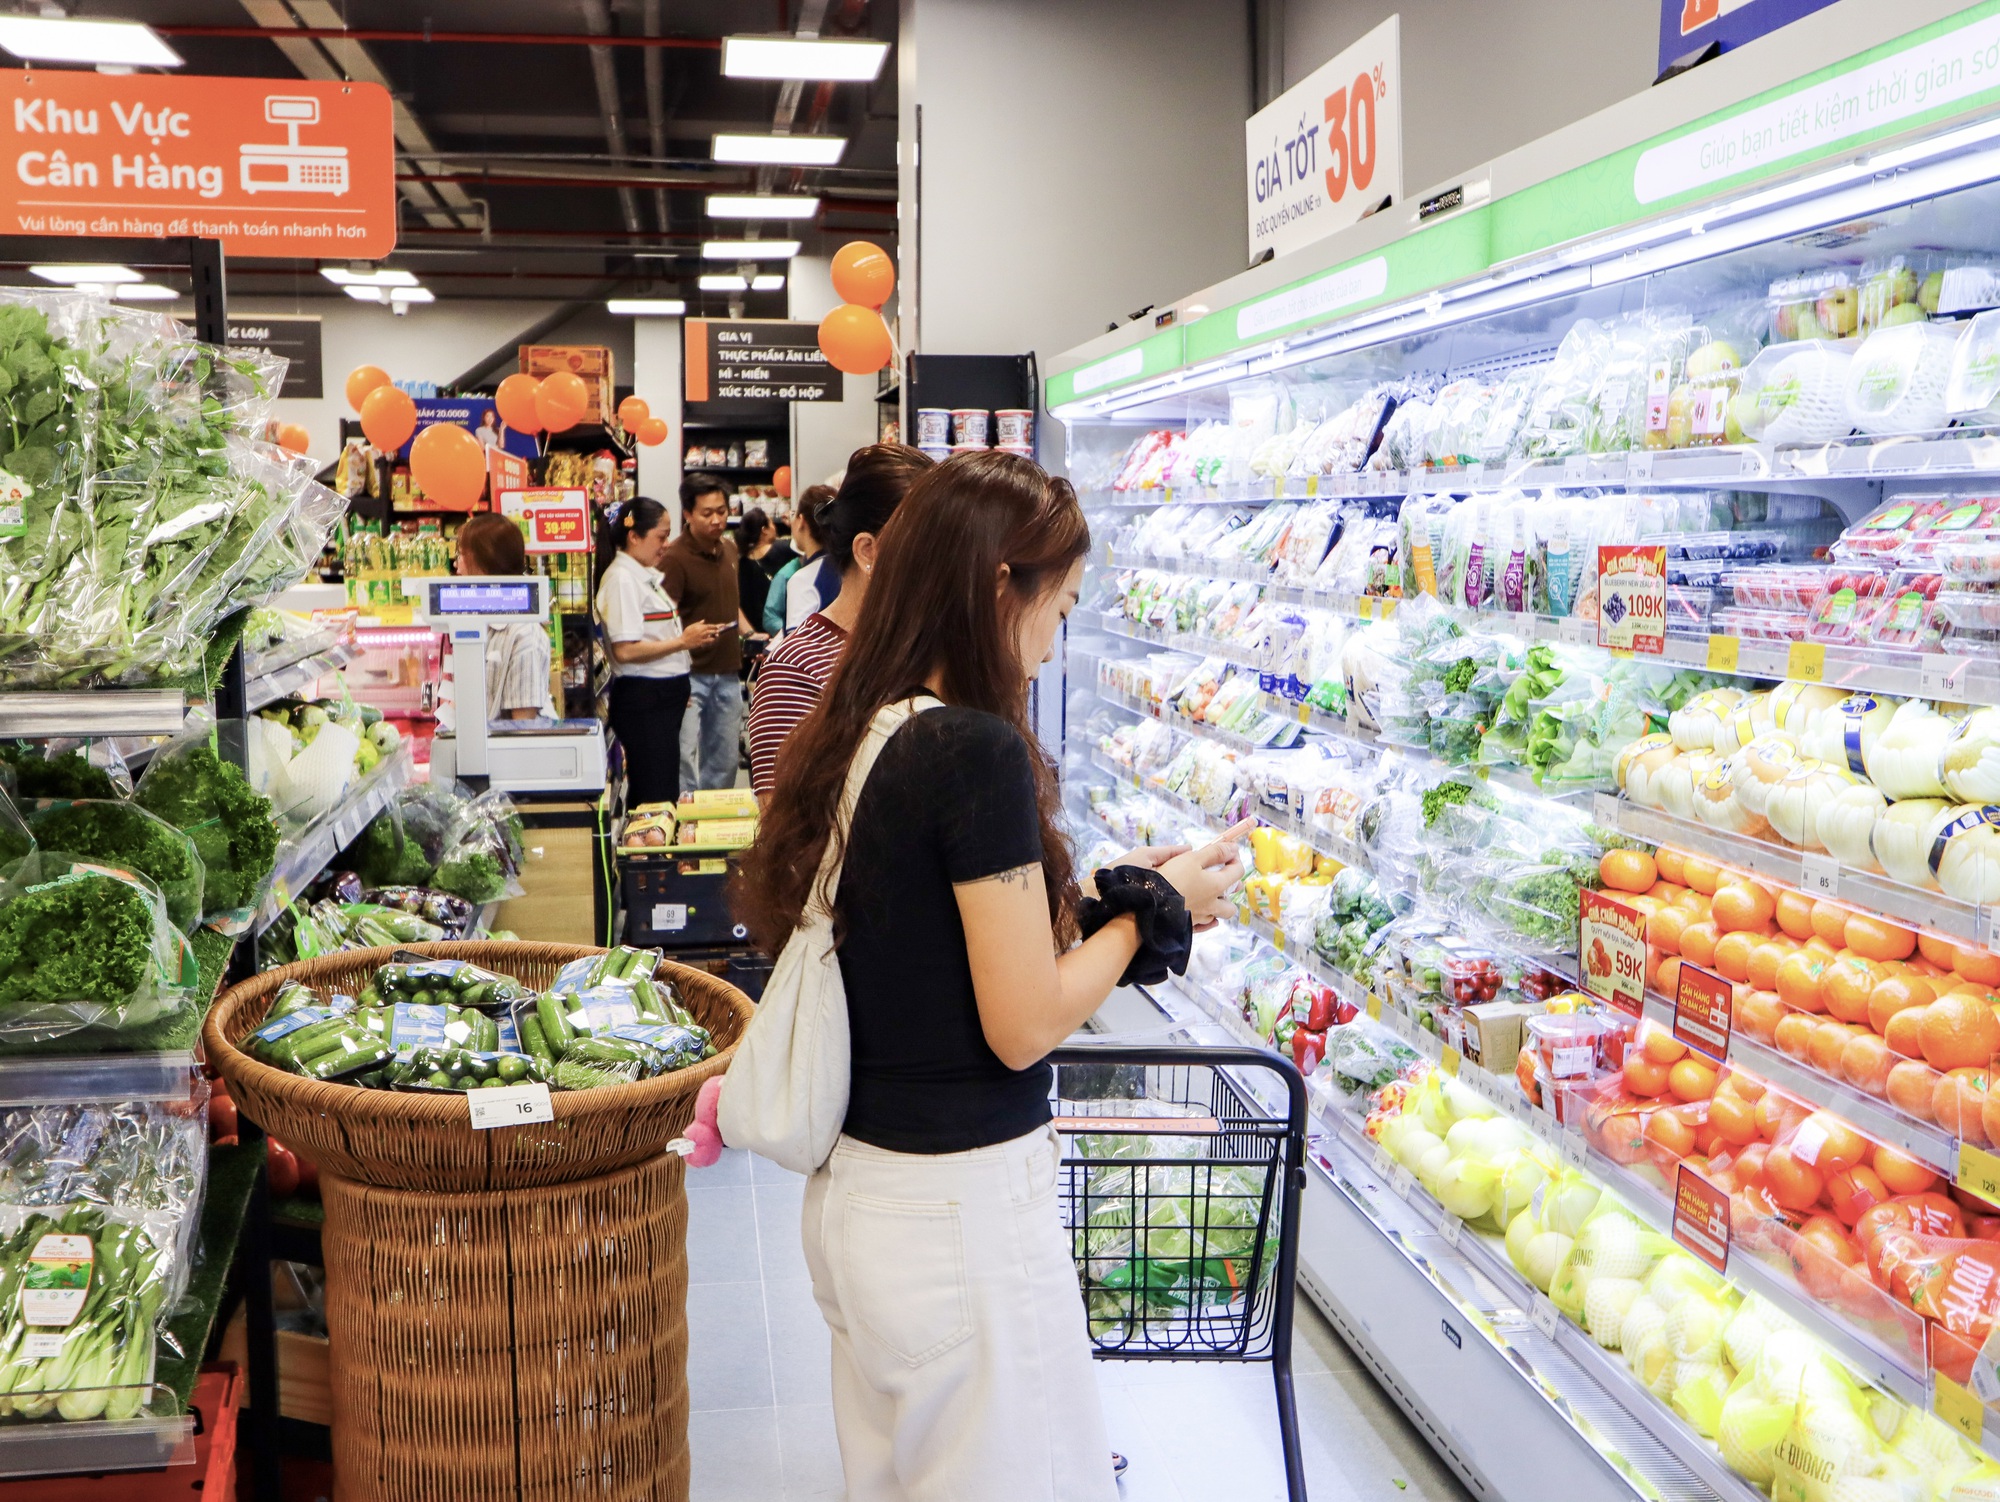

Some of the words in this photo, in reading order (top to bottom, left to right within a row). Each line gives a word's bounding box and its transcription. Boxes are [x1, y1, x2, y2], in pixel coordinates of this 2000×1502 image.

[14, 97, 99, 135] Khu
[110, 101, 190, 146] Vực
[1700, 134, 1736, 170] Giúp
[1742, 126, 1772, 160] bạn
[1778, 107, 1808, 141] tiết
[1814, 93, 1860, 134] kiệm
[1867, 75, 1908, 112] thời
[1915, 58, 1963, 103] gian
[1255, 135, 1282, 203] GIÁ
[1285, 111, 1319, 187] TỐT
[17, 149, 98, 188] Cân
[112, 151, 223, 198] Hàng
[1291, 194, 1314, 220] ONLINE
[18, 215, 45, 232] Vui
[50, 216, 85, 234] lòng
[90, 217, 119, 233] cân
[123, 218, 164, 236] hàng
[168, 217, 188, 234] để
[193, 220, 239, 235] thanh
[243, 220, 278, 236] toán
[283, 222, 333, 237] nhanh
[337, 223, 367, 238] hơn
[241, 327, 270, 341] LOẠI
[717, 331, 738, 342] GIA
[740, 332, 752, 344] VỊ
[718, 350, 749, 363] THỰC
[751, 348, 783, 362] PHẨM
[786, 349, 803, 362] ĂN
[718, 367, 732, 379] MÌ
[741, 367, 769, 380] MIẾN
[718, 386, 742, 398] XÚC
[743, 386, 770, 398] XÍCH
[779, 385, 797, 398] ĐỒ
[798, 386, 824, 400] HỘP
[1629, 594, 1662, 619] 109K
[1941, 678, 1954, 690] 119
[666, 909, 675, 919] 69
[1589, 905, 1600, 923] GIÁ
[1600, 906, 1618, 929] CHẤN
[1619, 914, 1639, 942] ĐỘNG
[1616, 950, 1642, 983] 59K
[1680, 983, 1693, 998] CÂN
[1693, 987, 1710, 1005] HÀNG
[1699, 1004, 1709, 1016] CÂN
[516, 1102, 533, 1114] 16
[1982, 1179, 1996, 1194] 129
[1680, 1186, 1692, 1200] CÂN
[1692, 1194, 1709, 1213] HÀNG
